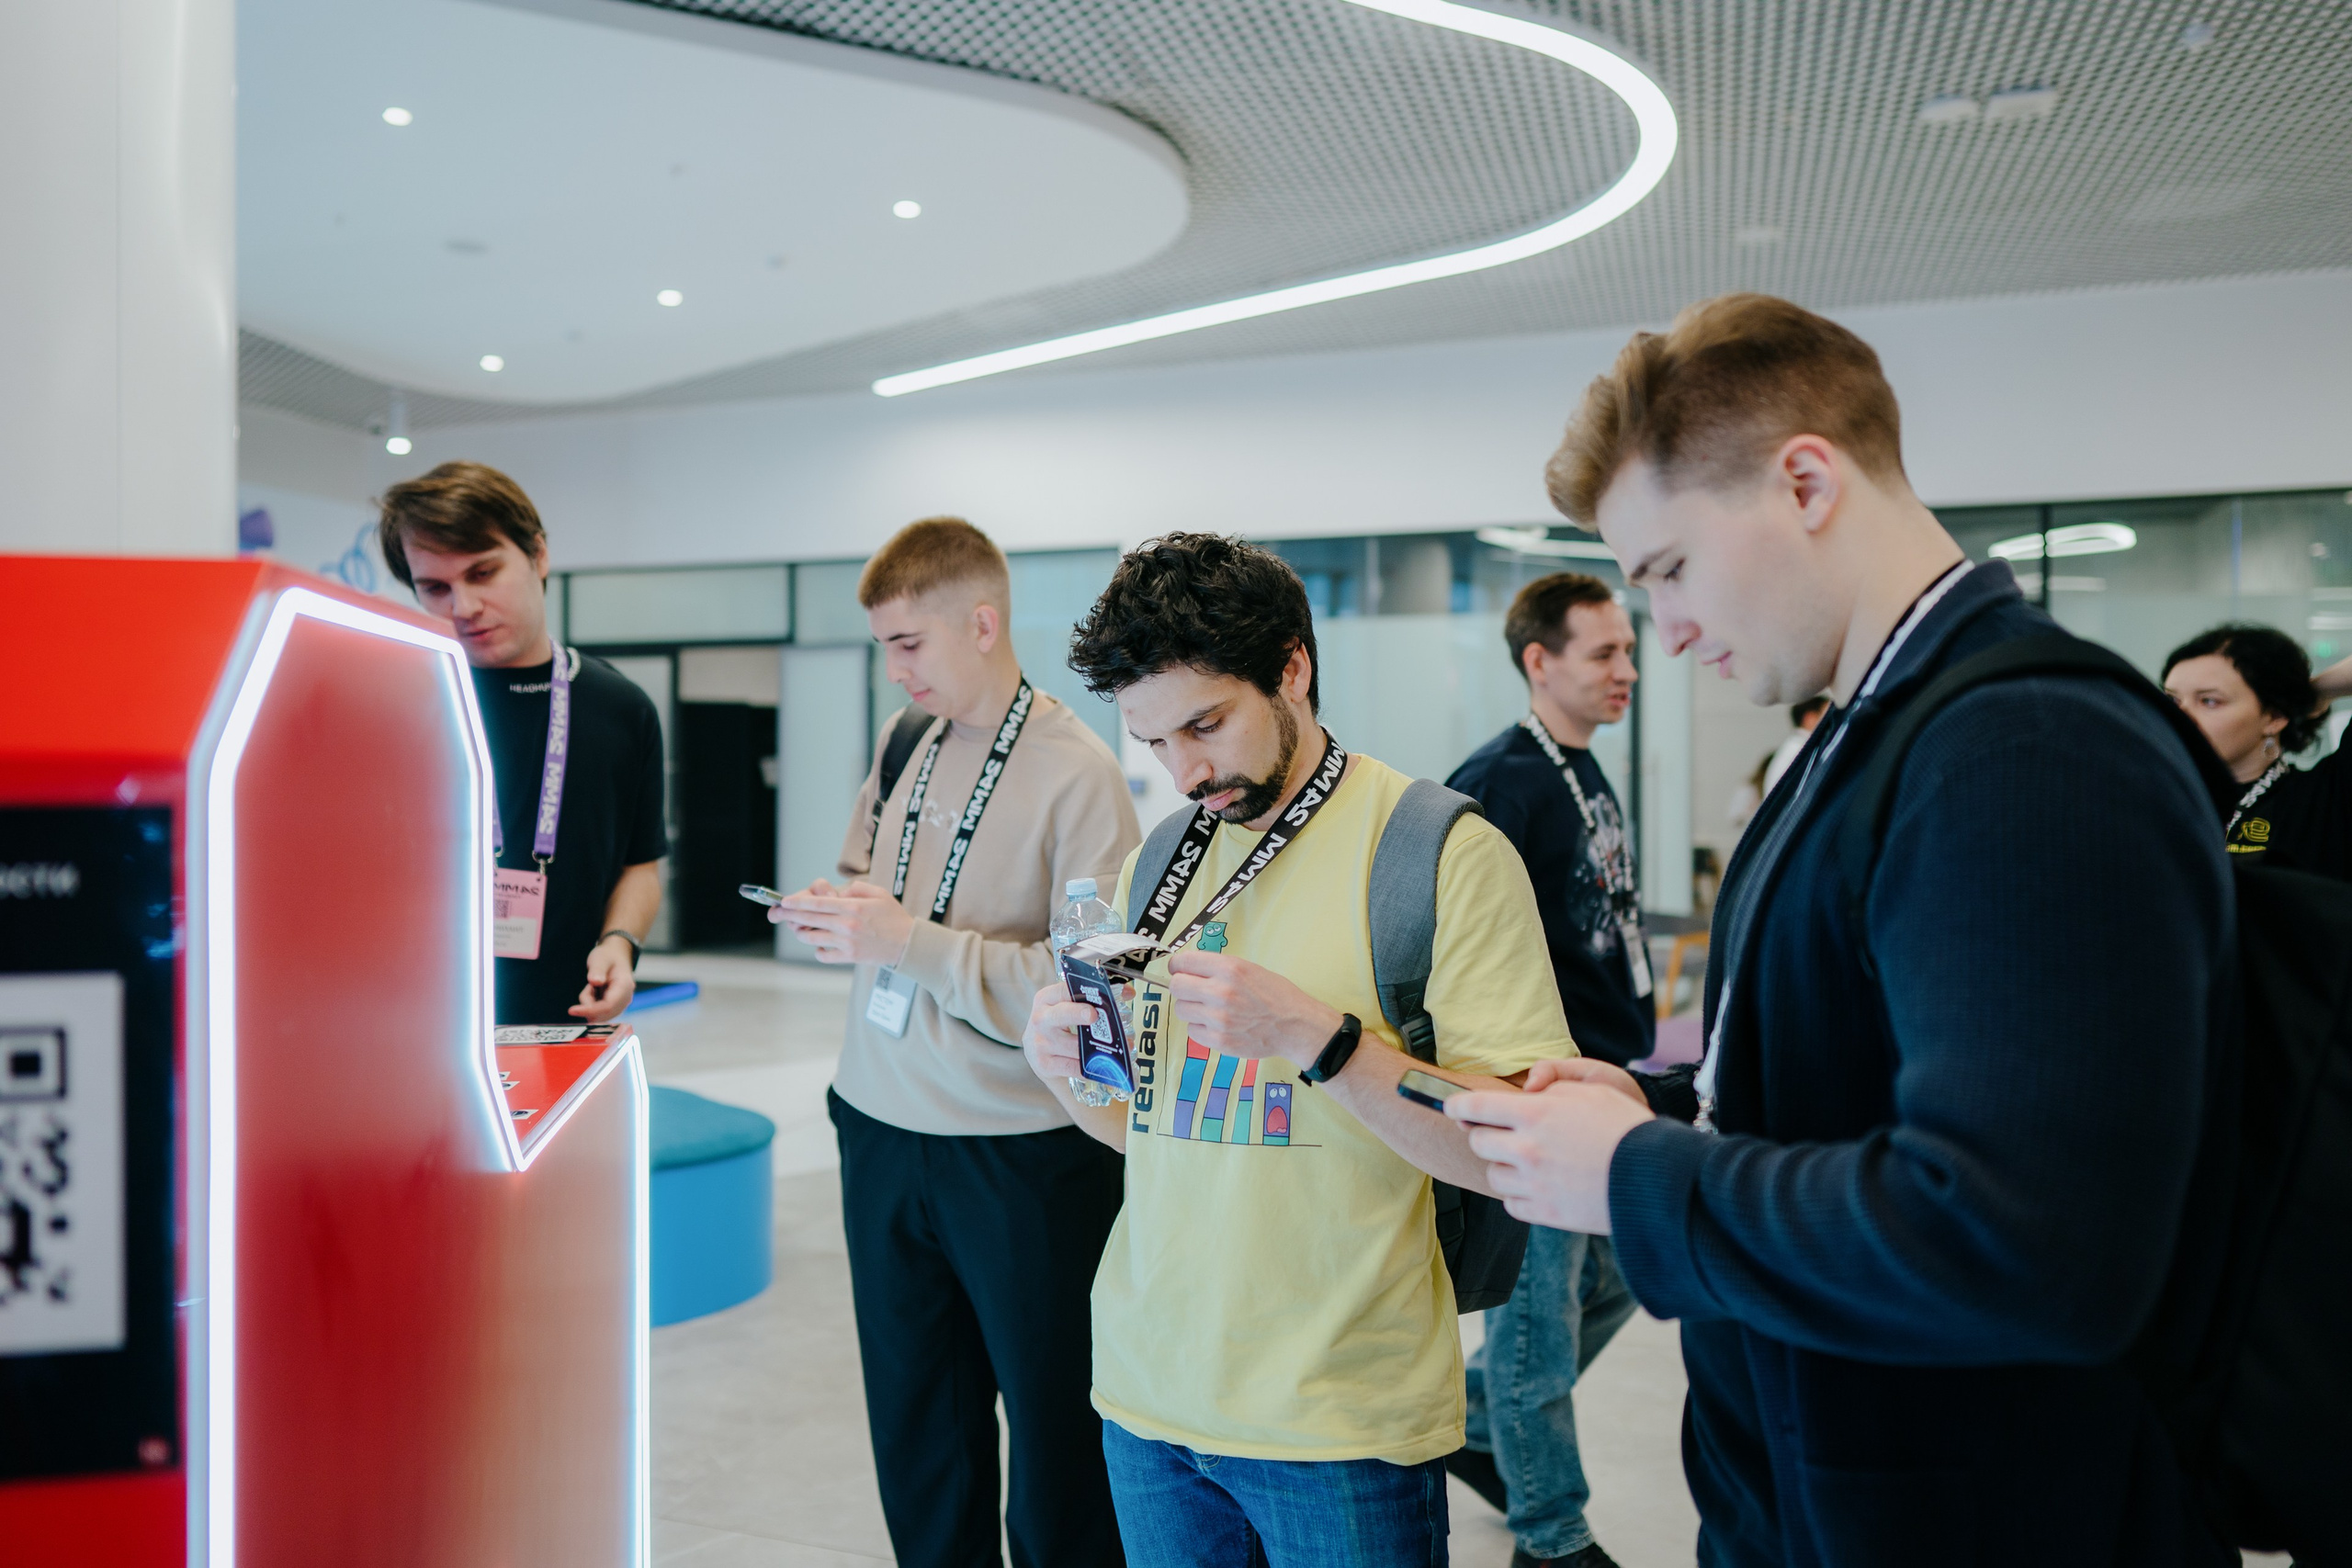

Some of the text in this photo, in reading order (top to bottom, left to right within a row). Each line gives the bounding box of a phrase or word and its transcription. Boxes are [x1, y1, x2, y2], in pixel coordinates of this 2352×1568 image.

[538, 761, 561, 835] MMAS
[963, 759, 1003, 831] MMAS
[934, 838, 968, 915] MMAS
